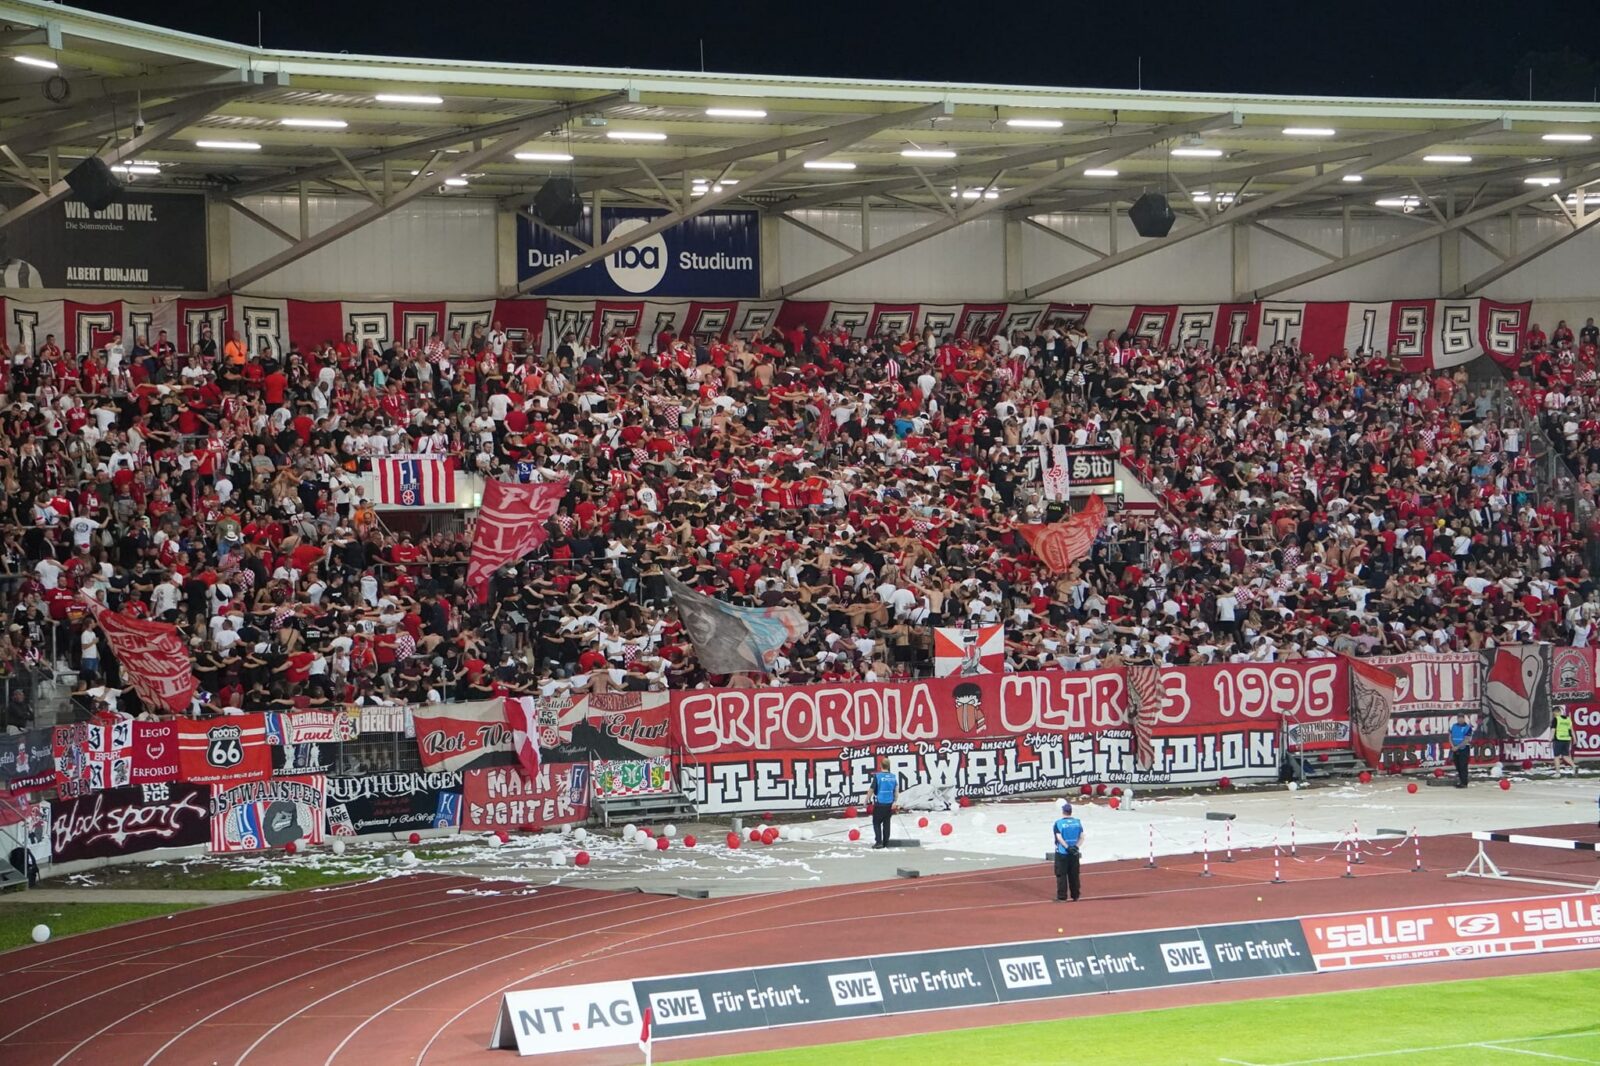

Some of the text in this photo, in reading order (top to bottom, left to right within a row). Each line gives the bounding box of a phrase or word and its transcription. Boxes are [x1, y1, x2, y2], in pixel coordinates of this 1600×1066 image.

[127, 204, 158, 222] RWE.
[65, 221, 78, 229] Die
[528, 248, 592, 269] Dual
[679, 252, 753, 271] Studium
[66, 266, 149, 282] ALBERT BUNJAKU
[1133, 308, 1302, 356] SEIT
[1361, 305, 1521, 358] 1966
[1073, 455, 1112, 479] Süd
[1117, 495, 1124, 510] S
[291, 711, 335, 725] WEIMARER
[681, 683, 938, 752] ERFORDIA
[1000, 671, 1191, 732] ULTRS
[1214, 663, 1337, 718] 1996
[140, 727, 170, 738] LEGIO
[213, 728, 239, 738] ROOTS
[362, 714, 404, 732] BERLIN
[605, 714, 669, 742] Erfurt
[1387, 717, 1416, 737] LOS
[294, 729, 334, 742] Land
[839, 746, 870, 761] Einst
[876, 743, 909, 755] warst
[981, 738, 1016, 750] unserer
[1023, 732, 1063, 748] Erfolge
[212, 740, 241, 764] 66
[957, 784, 984, 798] alten
[1025, 775, 1058, 790] werden
[1064, 776, 1082, 786] wir
[1110, 770, 1132, 784] ewig
[1138, 769, 1171, 782] sehnen
[143, 790, 170, 803] FCC
[805, 791, 860, 808] nach dem
[53, 791, 206, 853] Block sport
[470, 796, 576, 826] FIGHTER
[1166, 937, 1301, 967] SWE Für Erfurt.
[1006, 951, 1146, 983] SWE Für Erfurt.
[835, 966, 982, 999] SWE Für Erfurt.
[657, 984, 810, 1018] SWE Für Erfurt.
[518, 999, 634, 1037] NT.AG
